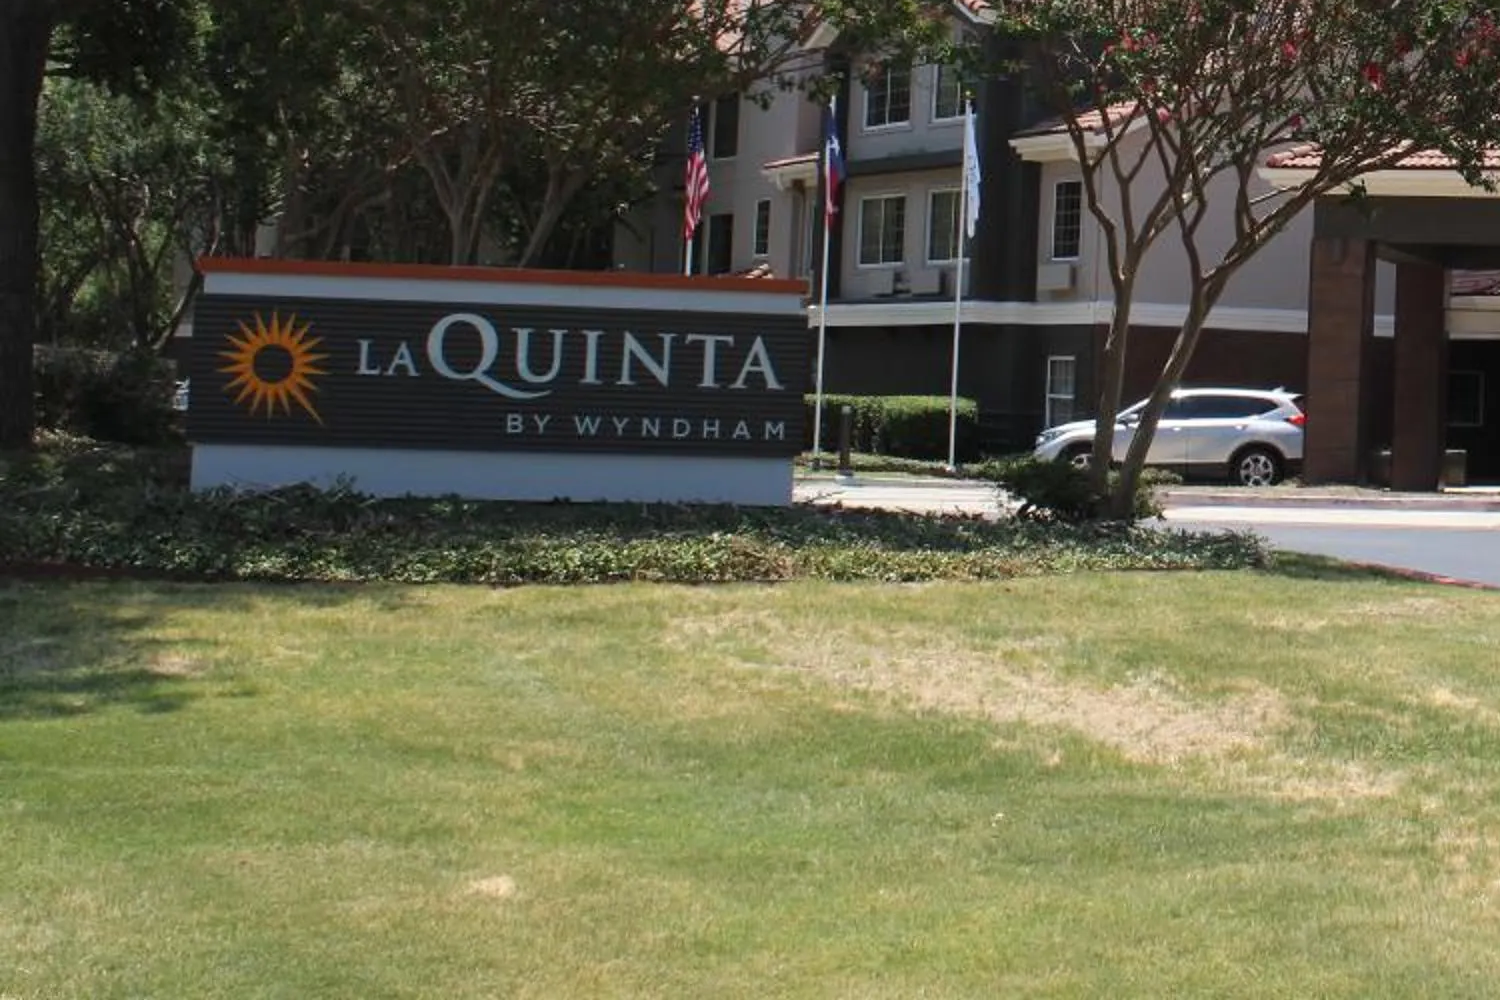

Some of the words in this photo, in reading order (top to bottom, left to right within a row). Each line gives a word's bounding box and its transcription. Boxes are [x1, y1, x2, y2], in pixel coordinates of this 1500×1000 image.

[356, 339, 419, 376] LA
[427, 312, 785, 399] QUINTA
[506, 413, 552, 434] BY
[574, 414, 787, 441] WYNDHAM
